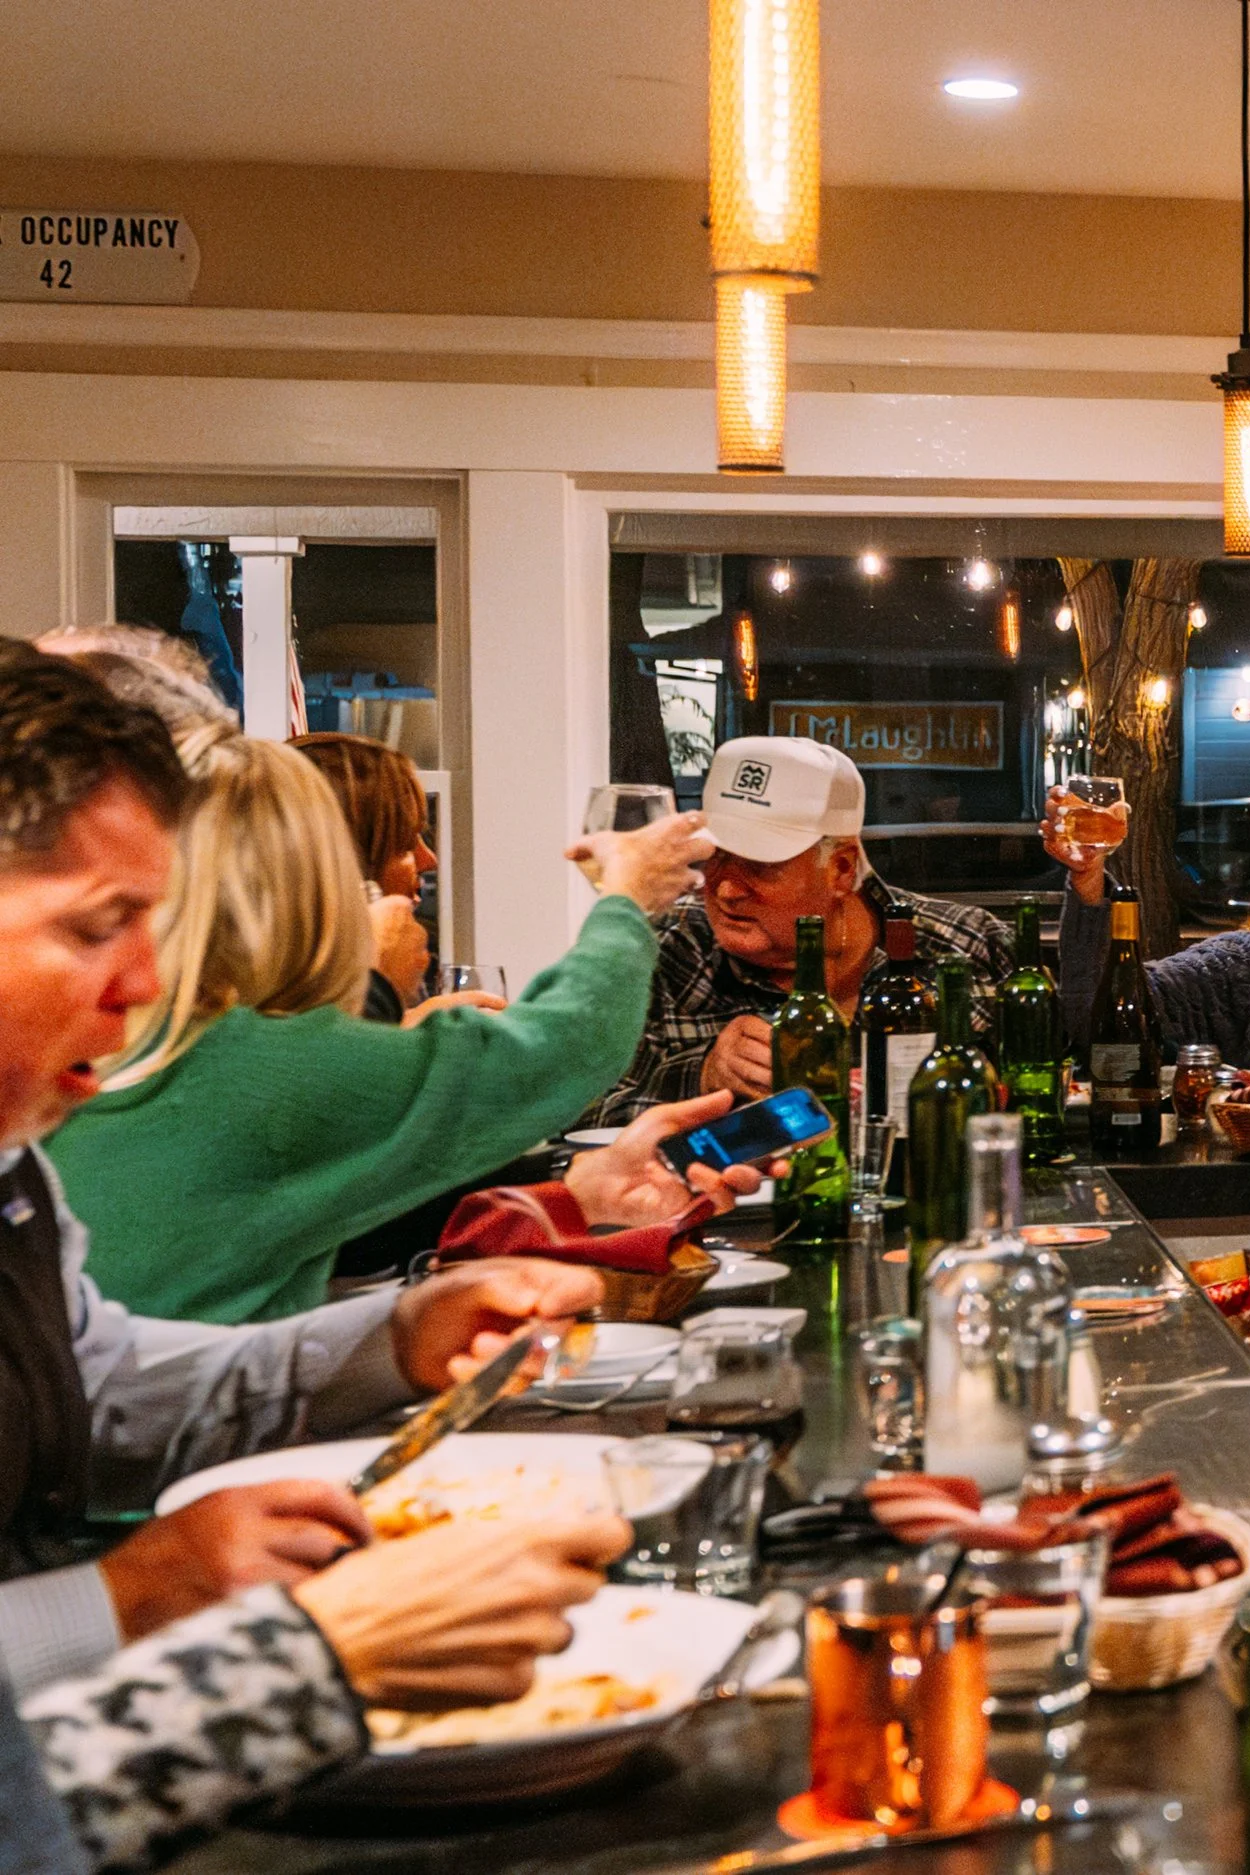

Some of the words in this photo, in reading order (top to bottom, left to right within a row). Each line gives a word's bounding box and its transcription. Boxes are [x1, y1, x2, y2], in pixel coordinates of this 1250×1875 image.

[20, 216, 179, 248] OCCUPANCY
[40, 259, 73, 289] 42
[737, 773, 764, 791] SR
